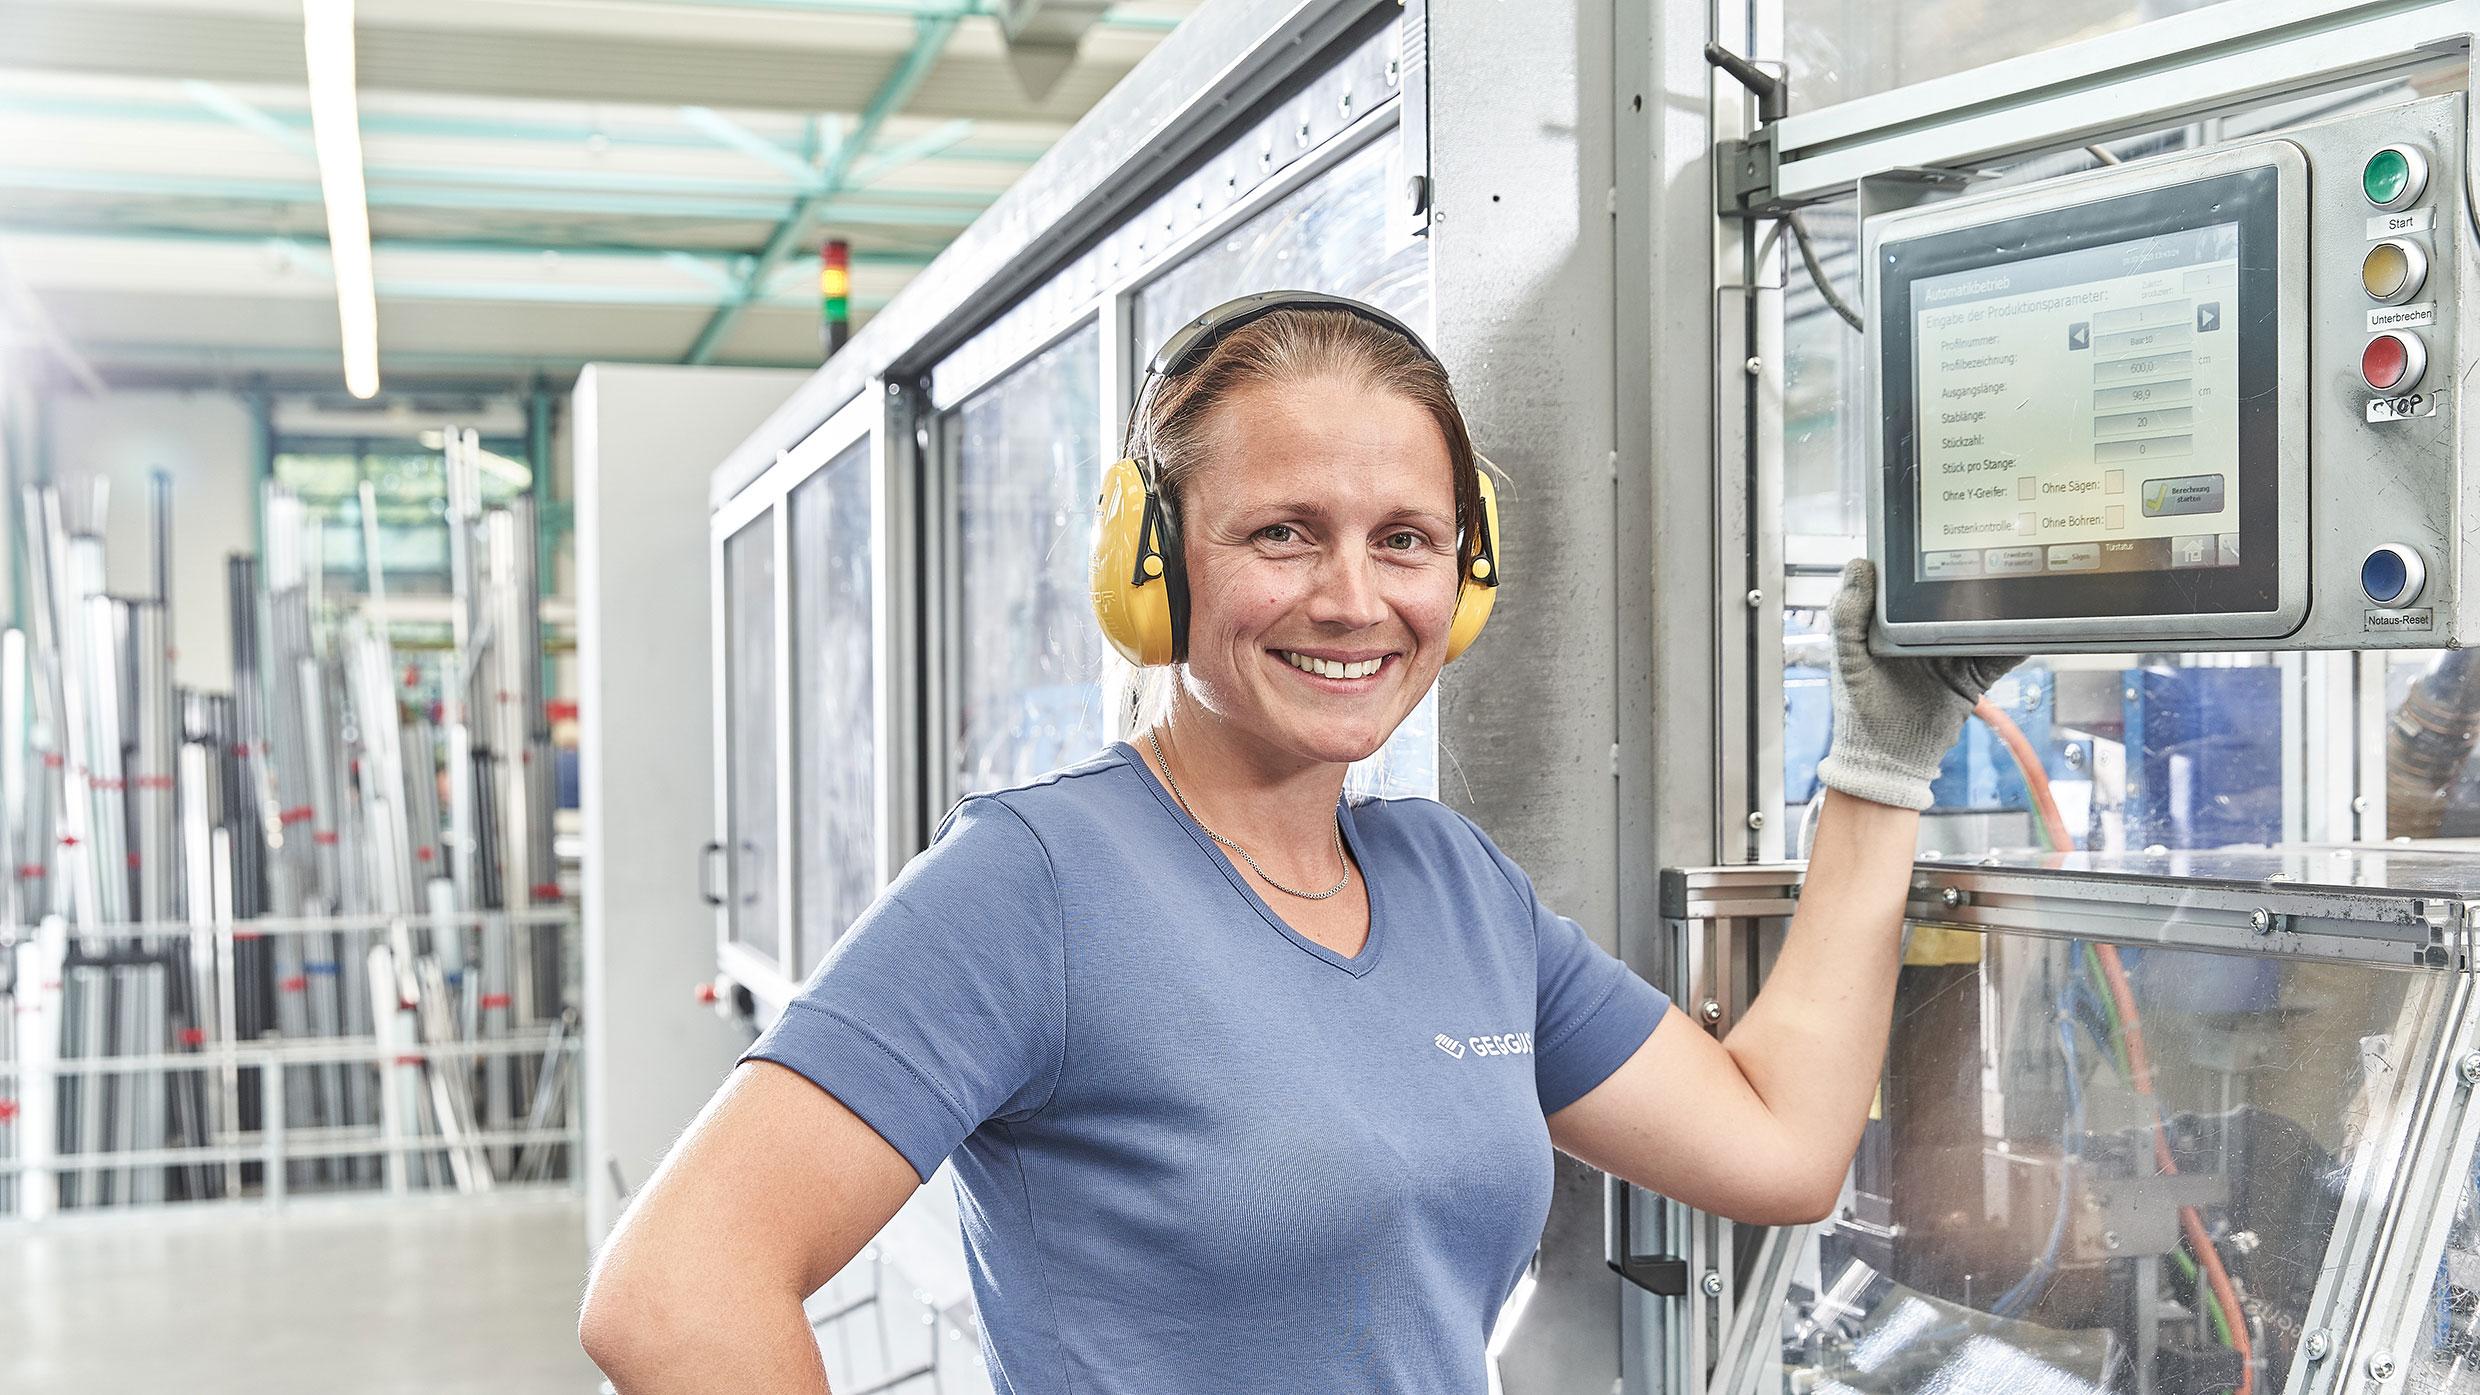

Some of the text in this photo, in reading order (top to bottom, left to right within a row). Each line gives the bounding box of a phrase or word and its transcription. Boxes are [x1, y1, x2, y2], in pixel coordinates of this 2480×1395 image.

[2389, 216, 2413, 230] Start
[1925, 277, 2011, 302] Automatikbetrieb
[1926, 291, 2109, 330] Eingabe der Produktionsparameter:
[2371, 310, 2432, 325] Unterbrechen
[1940, 335, 2000, 352] Profilnummer:
[1940, 353, 2018, 373] Profilbezeichnung:
[2198, 355, 2212, 365] cm
[1941, 382, 2008, 400] Ausgangslänge:
[2198, 387, 2212, 397] cm
[2137, 416, 2148, 428] 20
[1941, 433, 1985, 449] Stückzahl:
[2139, 444, 2146, 455] 0
[1942, 458, 2017, 474] Stück pro Stange:
[1942, 486, 2008, 501] Ohne Y-Greifer:
[2042, 480, 2101, 494] Ohne Sägen:
[2042, 514, 2105, 529] Ohne Bohren:
[2368, 614, 2429, 626] Notaus-Reset
